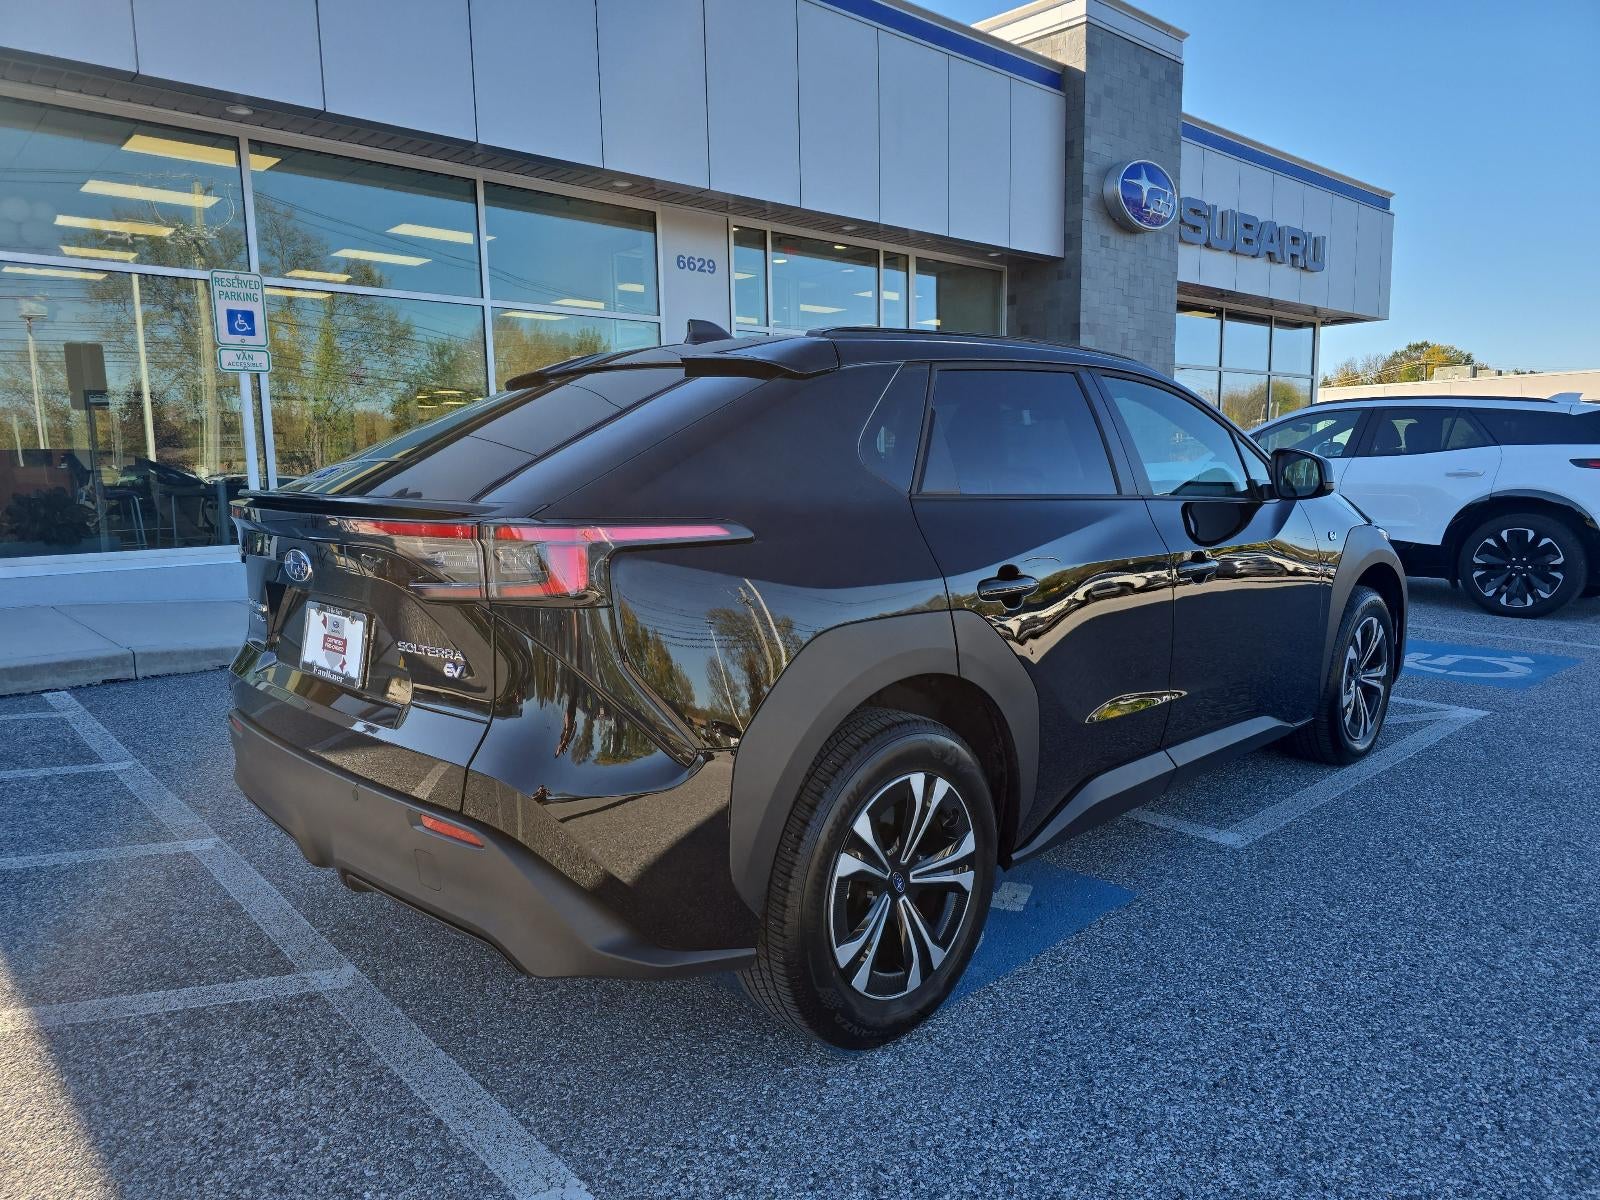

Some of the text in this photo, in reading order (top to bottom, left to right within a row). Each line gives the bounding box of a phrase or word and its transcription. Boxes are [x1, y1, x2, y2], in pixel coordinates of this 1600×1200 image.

[1180, 197, 1327, 273] SUBARU
[676, 254, 716, 275] 6629
[214, 277, 260, 290] RESERVED
[218, 291, 259, 303] PARKING
[236, 353, 254, 361] VAN
[397, 641, 466, 661] SOLTERRA
[313, 665, 344, 684] Faulkner
[443, 662, 465, 679] EV
